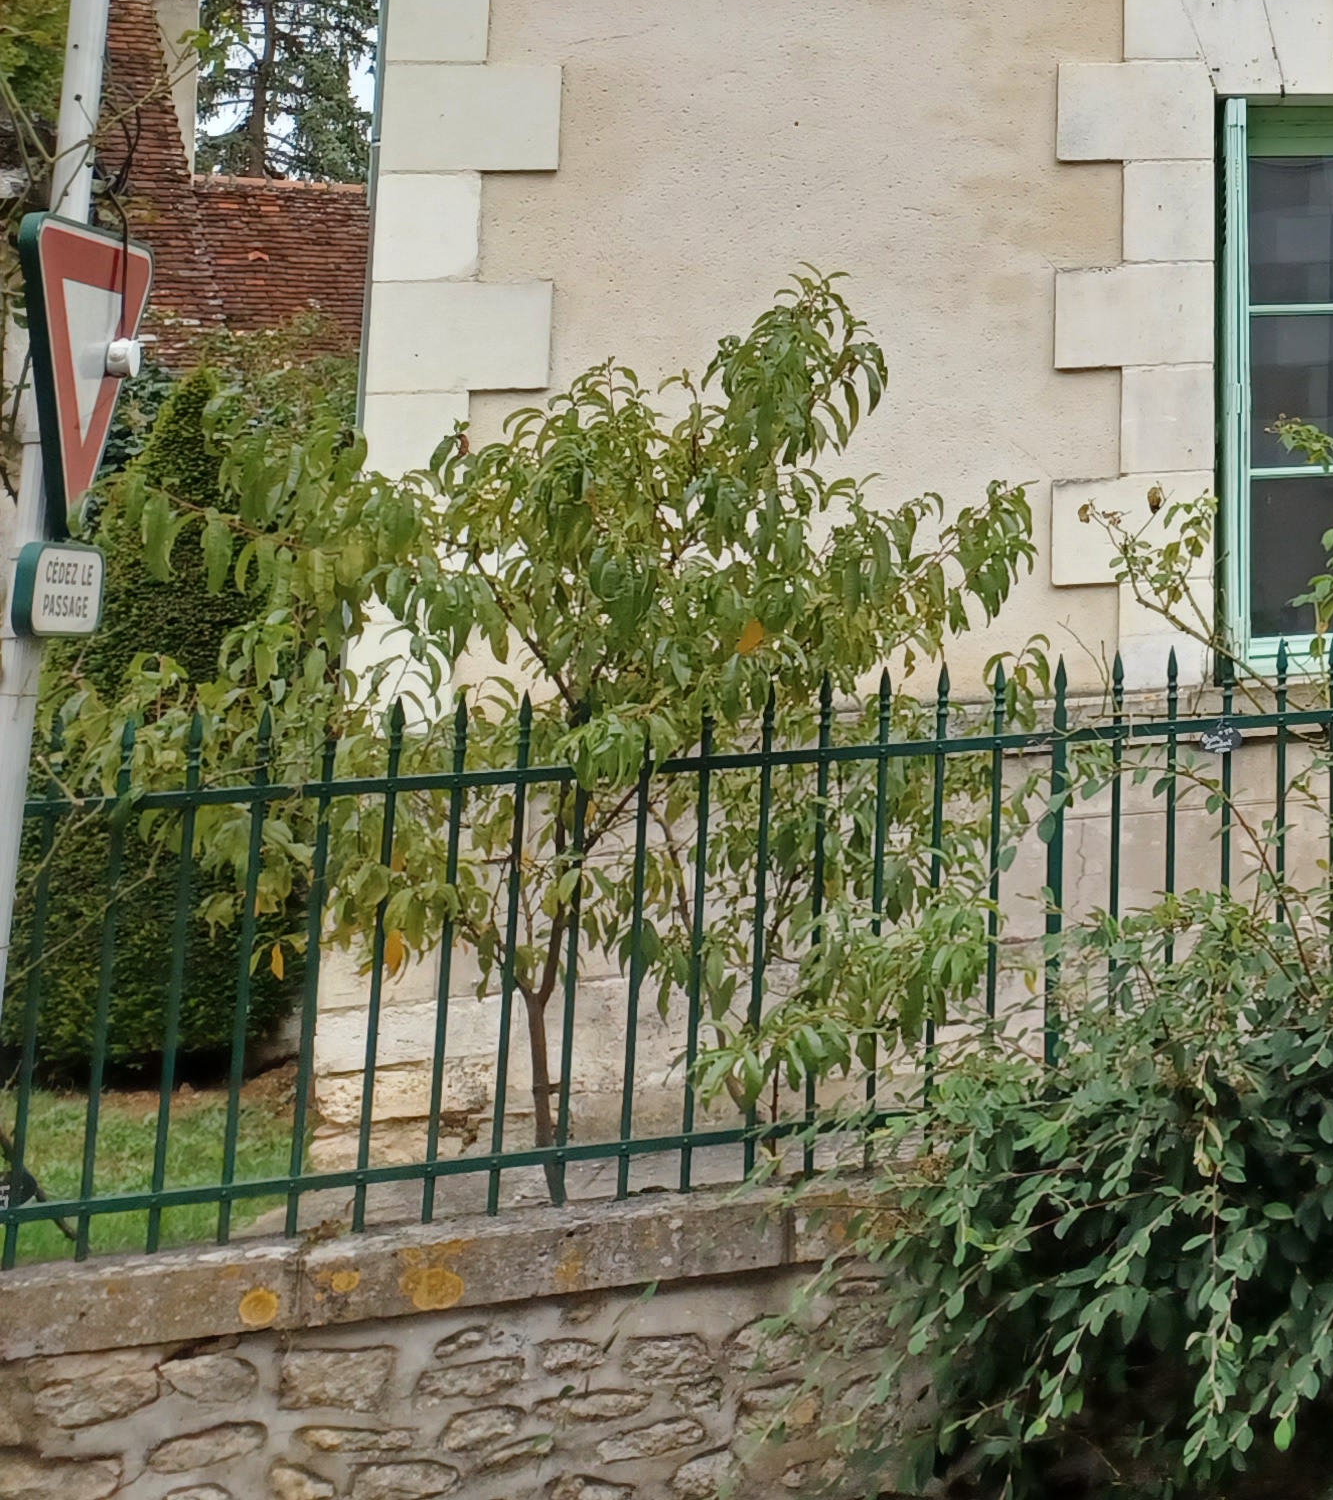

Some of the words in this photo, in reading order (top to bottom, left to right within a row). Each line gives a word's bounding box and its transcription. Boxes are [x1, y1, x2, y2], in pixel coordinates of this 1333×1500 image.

[45, 556, 78, 585] CÉDEZ
[81, 564, 94, 586] LE
[43, 594, 89, 619] PASSAGE
